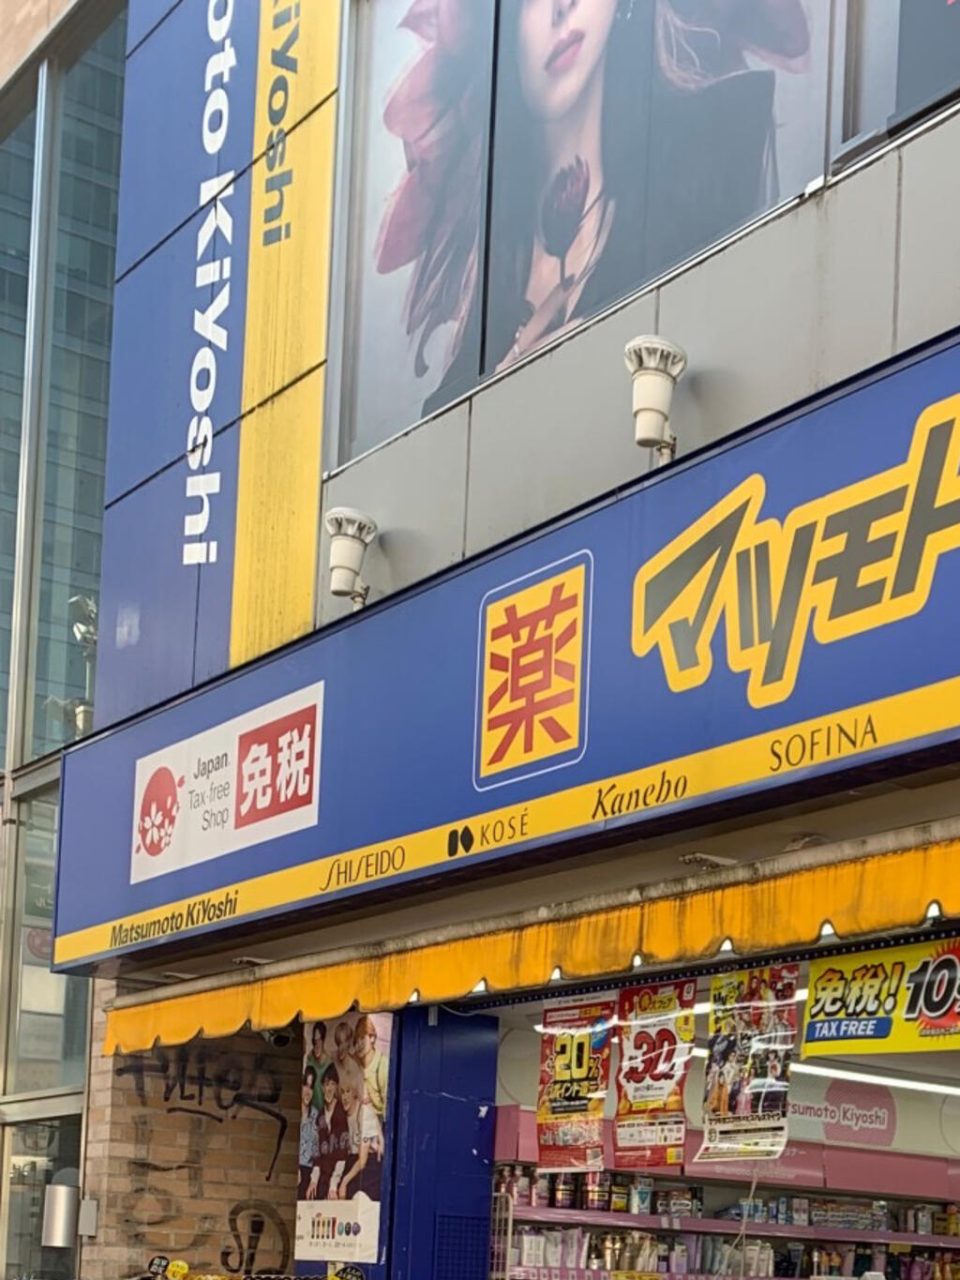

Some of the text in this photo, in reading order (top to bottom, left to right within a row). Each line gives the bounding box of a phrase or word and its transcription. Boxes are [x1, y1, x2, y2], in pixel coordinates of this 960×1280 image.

[262, 0, 300, 247] iYoshi
[486, 582, 580, 767] 薬
[193, 750, 230, 781] Japan
[769, 714, 879, 774] SOFINA
[239, 722, 313, 818] 免税
[187, 780, 231, 811] Tax-free
[201, 807, 229, 831] Shop
[592, 771, 688, 820] Kanebo
[480, 808, 529, 847] KOSÉ
[320, 845, 406, 892] SHISEIDO
[110, 889, 238, 949] Matsumoto KiYoshi
[809, 961, 906, 1019] 免税!
[814, 1019, 878, 1038] TAX FREE
[841, 1106, 888, 1129] Kiyoshi
